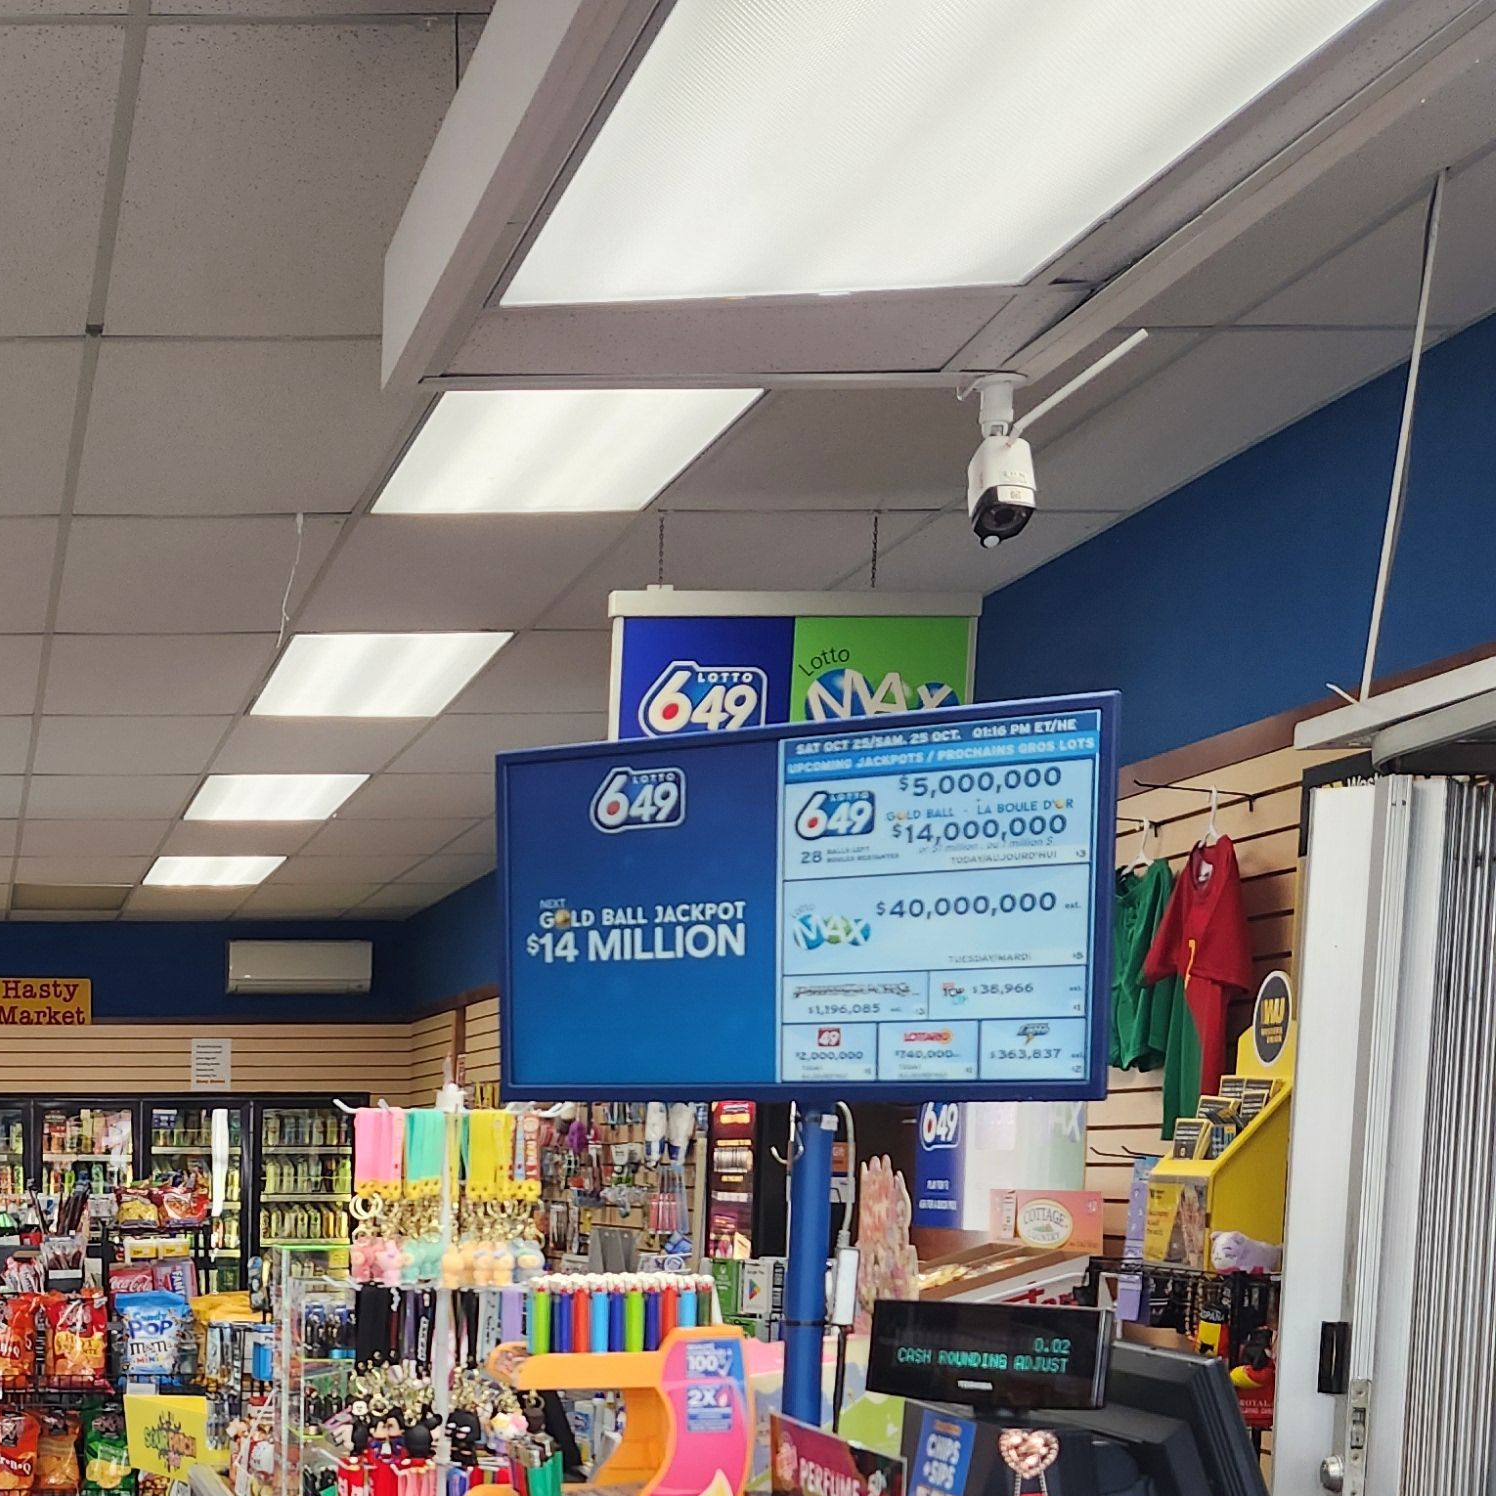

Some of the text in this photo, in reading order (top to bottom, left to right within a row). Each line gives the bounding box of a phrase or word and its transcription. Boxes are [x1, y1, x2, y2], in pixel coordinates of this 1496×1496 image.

[799, 648, 850, 677] Lotto
[698, 672, 753, 683] LOTTO
[648, 670, 758, 732] 649
[807, 668, 953, 722] MAX
[796, 743, 822, 755] SAT
[823, 740, 848, 753] OCT
[910, 732, 929, 745] 25
[1010, 721, 1031, 733] PM
[787, 736, 1094, 773] UPCOMING JACKPOTS PROCHAINS GROS LOTS
[632, 773, 676, 784] LOTTO
[899, 766, 1061, 798] $5,000,000
[598, 775, 679, 826] 649
[886, 810, 921, 821] GOLD
[926, 809, 954, 819] BALL
[978, 805, 991, 815] LA
[997, 801, 1037, 813] BOULE
[796, 791, 872, 840] 649
[892, 814, 1067, 845] $14,000,000
[801, 851, 822, 863] 28
[539, 898, 566, 909] NEXT
[539, 901, 746, 929] GOLD BALL JACKPOT
[876, 892, 1057, 920] $40,000,000
[526, 922, 746, 963] $14 MILLION
[793, 913, 871, 950] MAX
[2, 980, 79, 1002] Hasty
[923, 1102, 958, 1142] 649
[1023, 1204, 1065, 1228] COTTAGE
[127, 1320, 173, 1338] POP
[1034, 1337, 1071, 1354] 0.02
[897, 1347, 1070, 1373] CASH ROUNDING ADJUST
[688, 1388, 718, 1406] 2X
